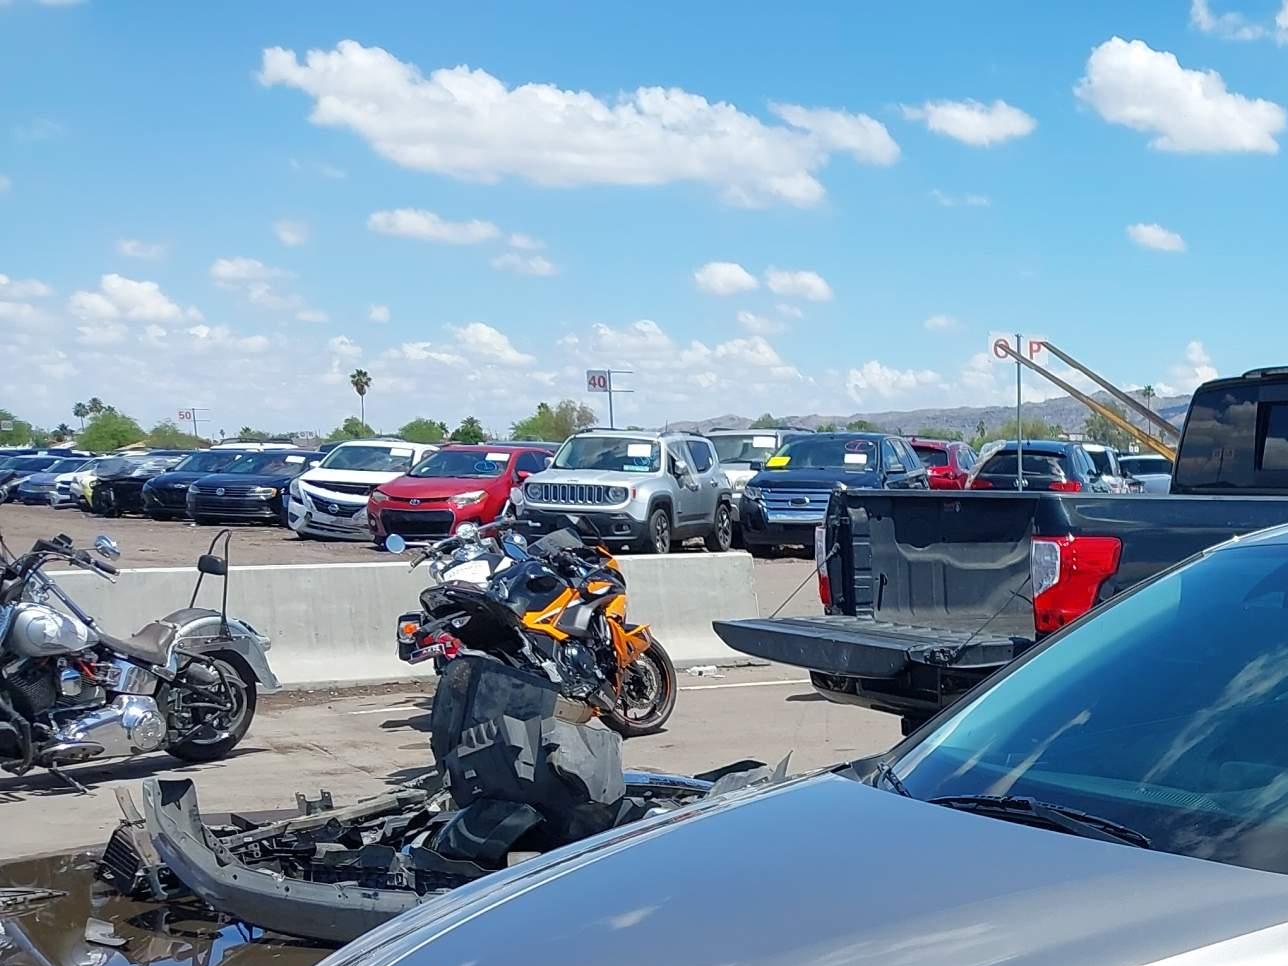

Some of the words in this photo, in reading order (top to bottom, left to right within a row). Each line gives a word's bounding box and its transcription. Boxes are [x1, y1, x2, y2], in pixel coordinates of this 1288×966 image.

[993, 338, 1009, 359] O
[1029, 341, 1041, 360] P
[588, 375, 606, 389] 40
[178, 411, 192, 420] 50
